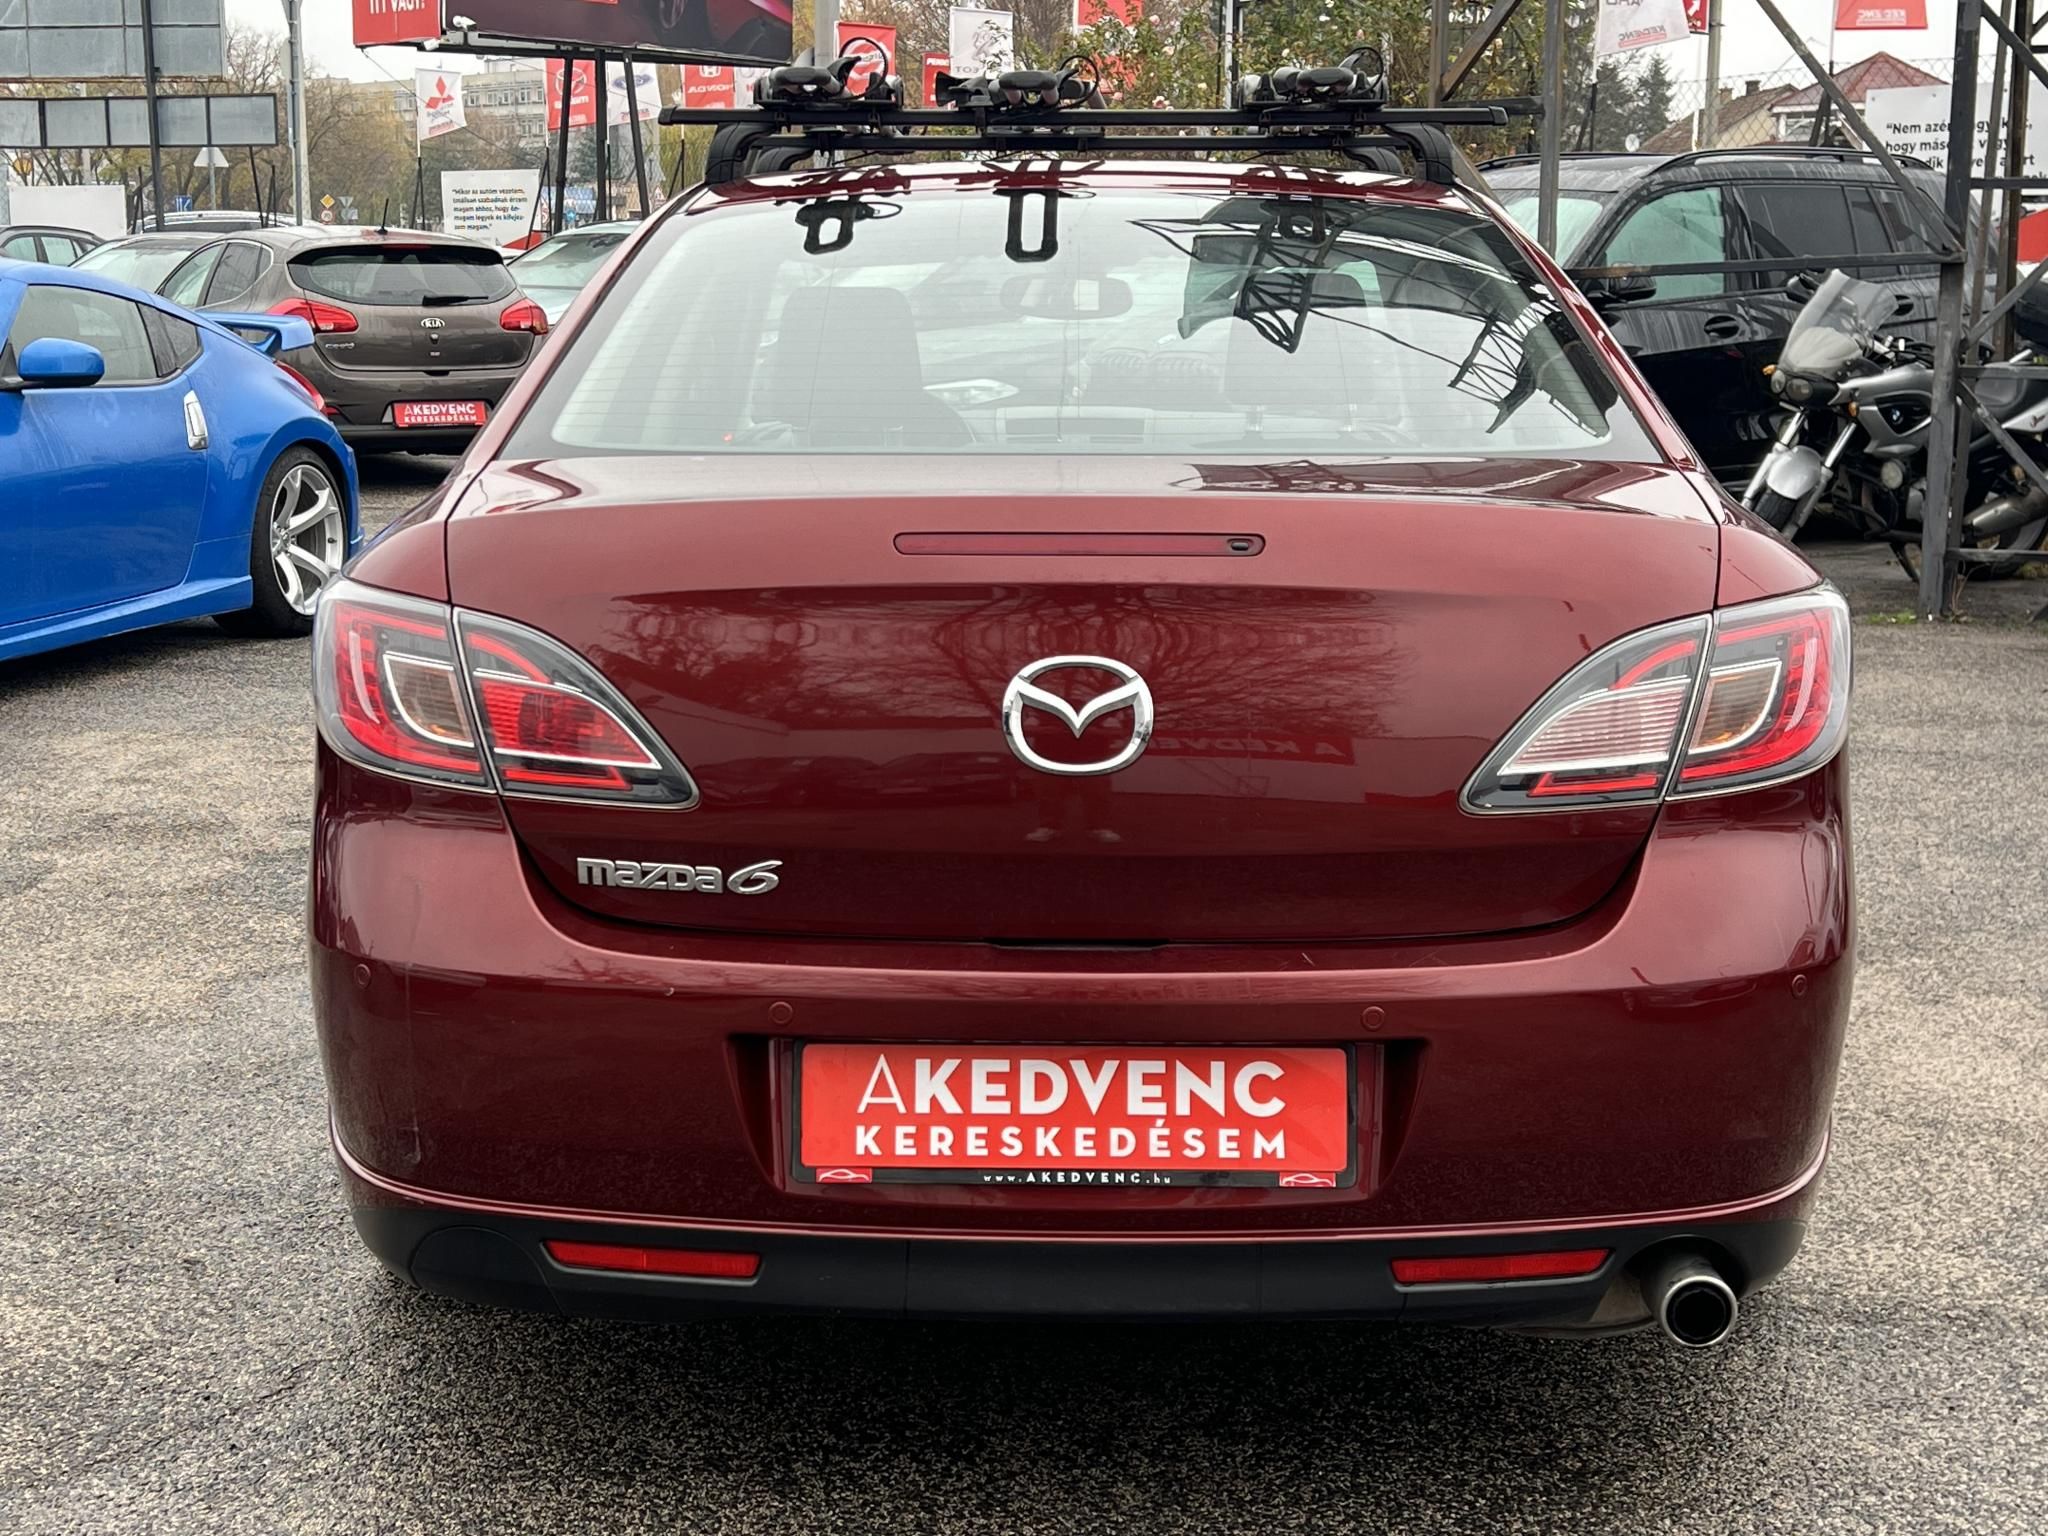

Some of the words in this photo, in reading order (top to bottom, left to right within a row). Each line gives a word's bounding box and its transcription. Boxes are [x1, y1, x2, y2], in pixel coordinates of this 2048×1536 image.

[1885, 141, 1916, 154] hogy
[855, 1119, 1287, 1161] KERESKEDÉSEM
[983, 1172, 1171, 1184] www.AKEDVENC.hu
